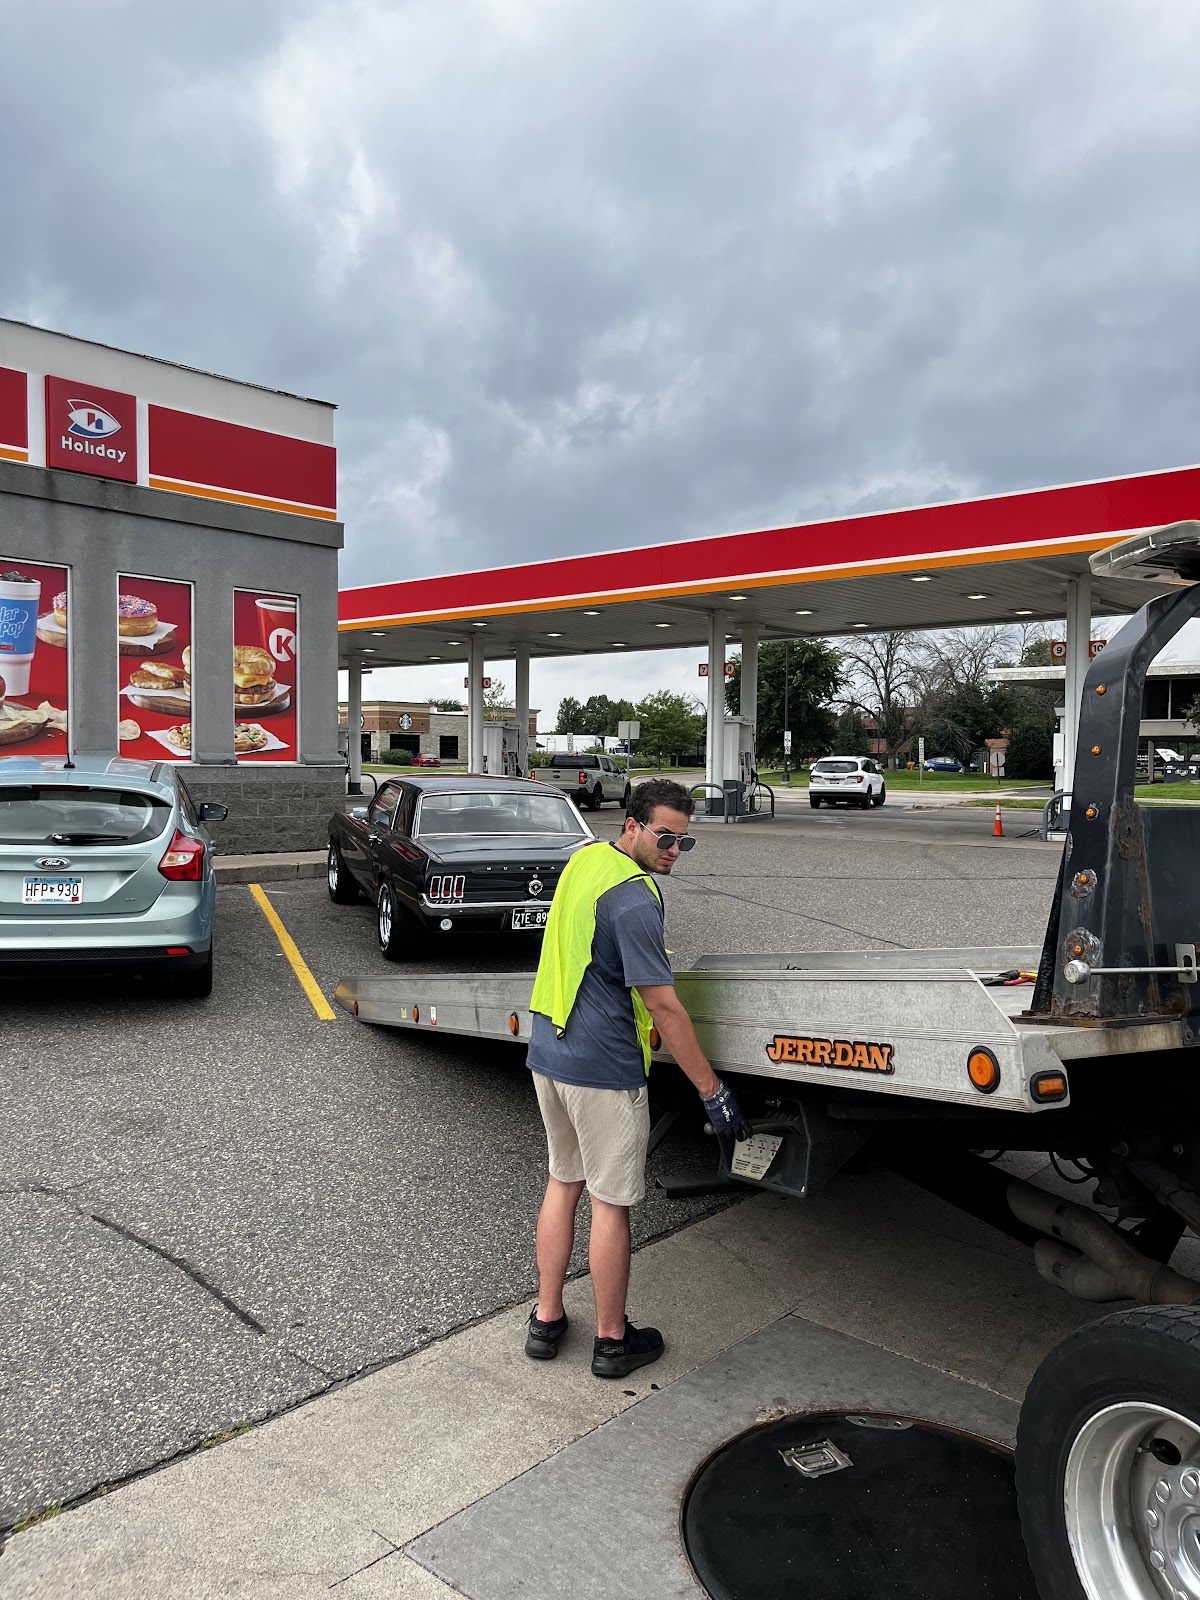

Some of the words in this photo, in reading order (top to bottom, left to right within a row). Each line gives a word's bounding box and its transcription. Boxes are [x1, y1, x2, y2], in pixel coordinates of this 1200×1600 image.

[61, 435, 127, 463] Holiday
[0, 621, 24, 639] Pop
[276, 634, 297, 660] K
[25, 883, 49, 897] HFP
[57, 883, 79, 897] 930
[514, 912, 532, 925] ZTE
[536, 912, 549, 923] 89
